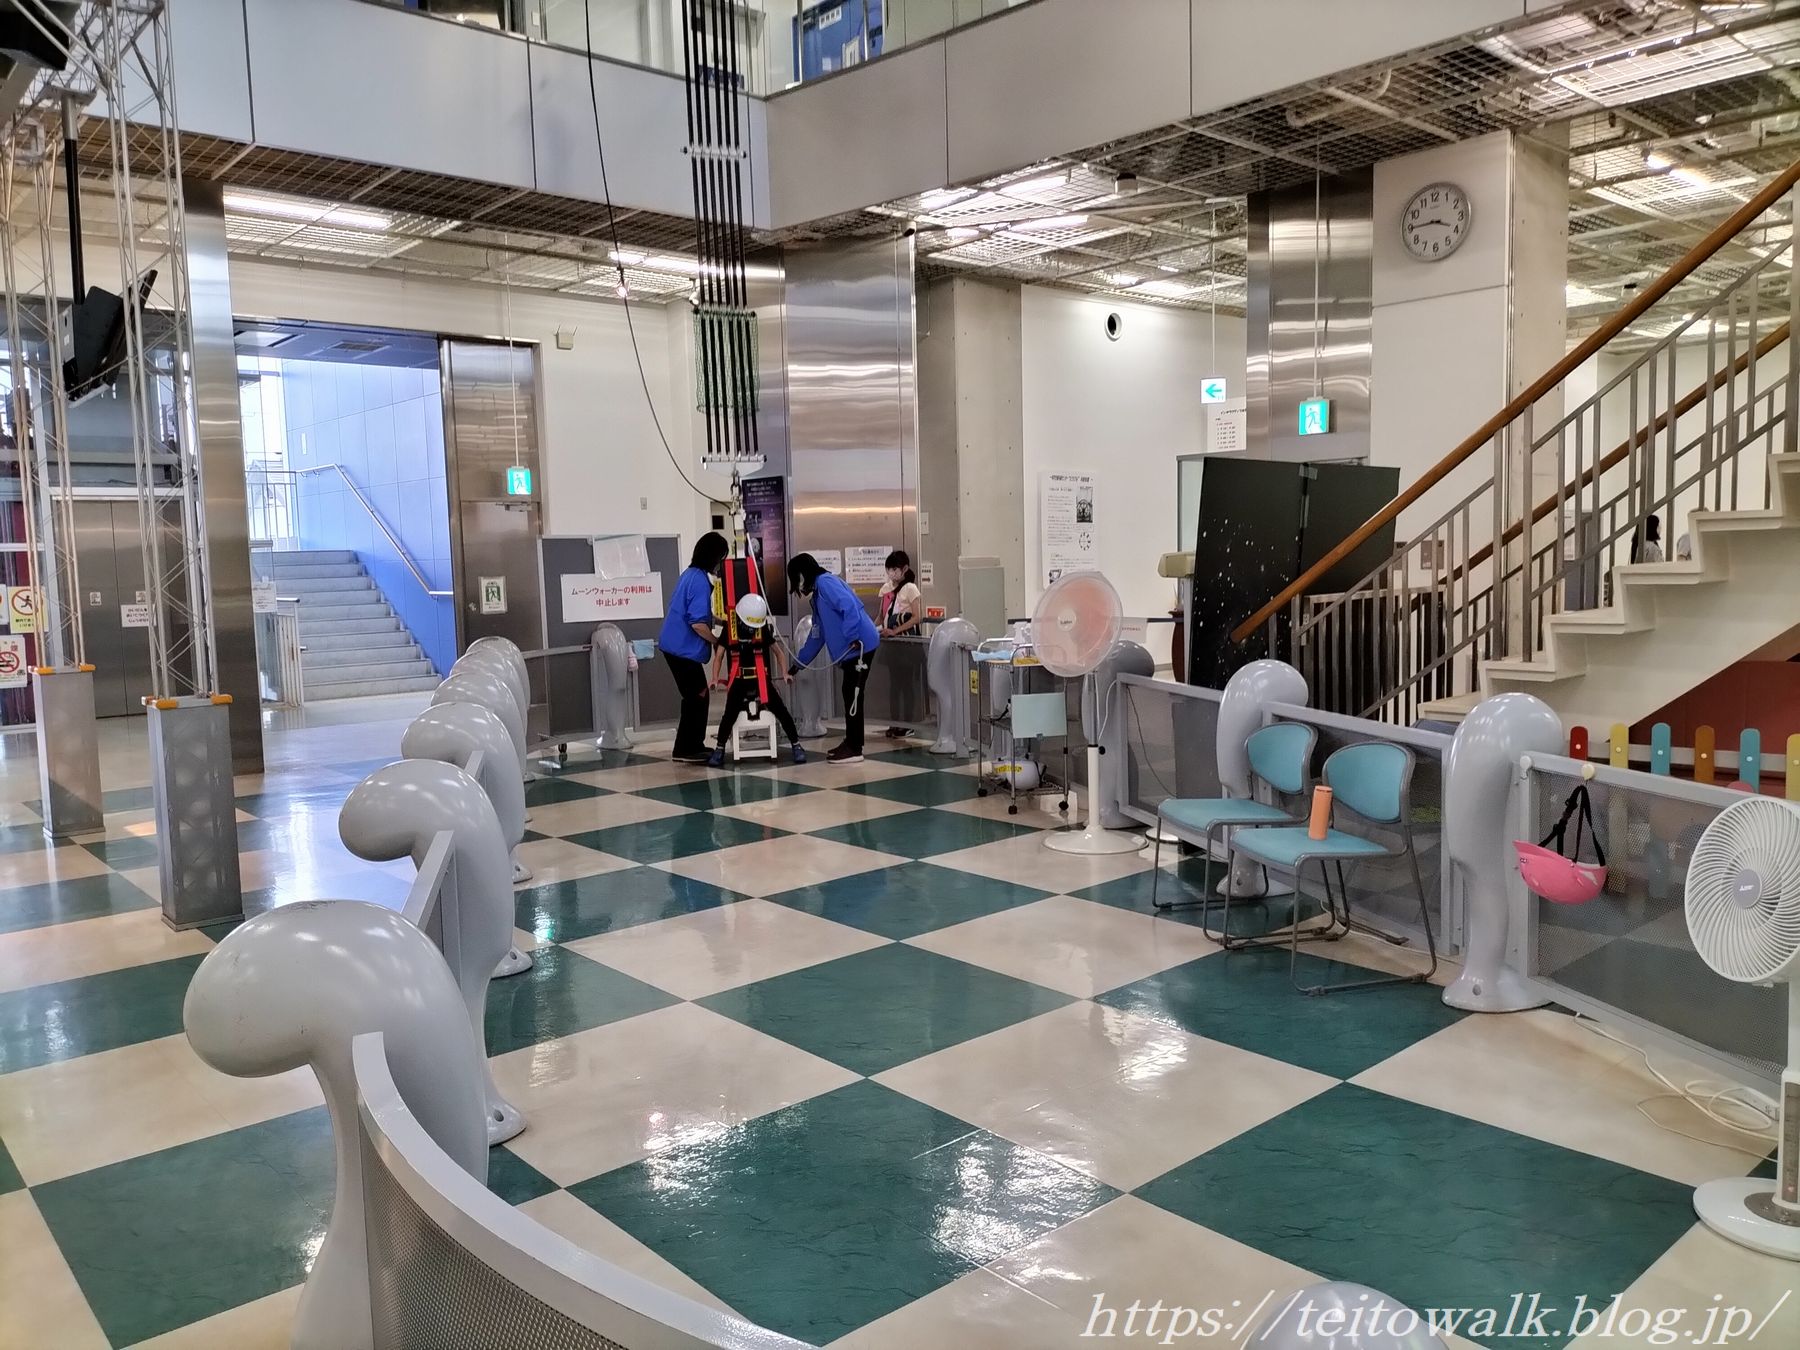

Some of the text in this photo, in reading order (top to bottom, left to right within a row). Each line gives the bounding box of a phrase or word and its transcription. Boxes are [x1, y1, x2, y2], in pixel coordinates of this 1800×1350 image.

[1431, 192, 1440, 202] 12
[1445, 192, 1449, 202] 1
[1420, 198, 1427, 208] 11
[1453, 199, 1460, 209] 2
[1411, 209, 1420, 220] 10
[1457, 210, 1464, 221] 3
[1407, 223, 1414, 233] 9
[1453, 224, 1459, 234] 4
[1413, 234, 1420, 245] 8
[1445, 236, 1451, 246] 5
[1422, 240, 1428, 251] 7
[1433, 242, 1439, 253] 6
[571, 585, 652, 596] ムーンウォーカーの利用は
[596, 598, 630, 607] 中止します
